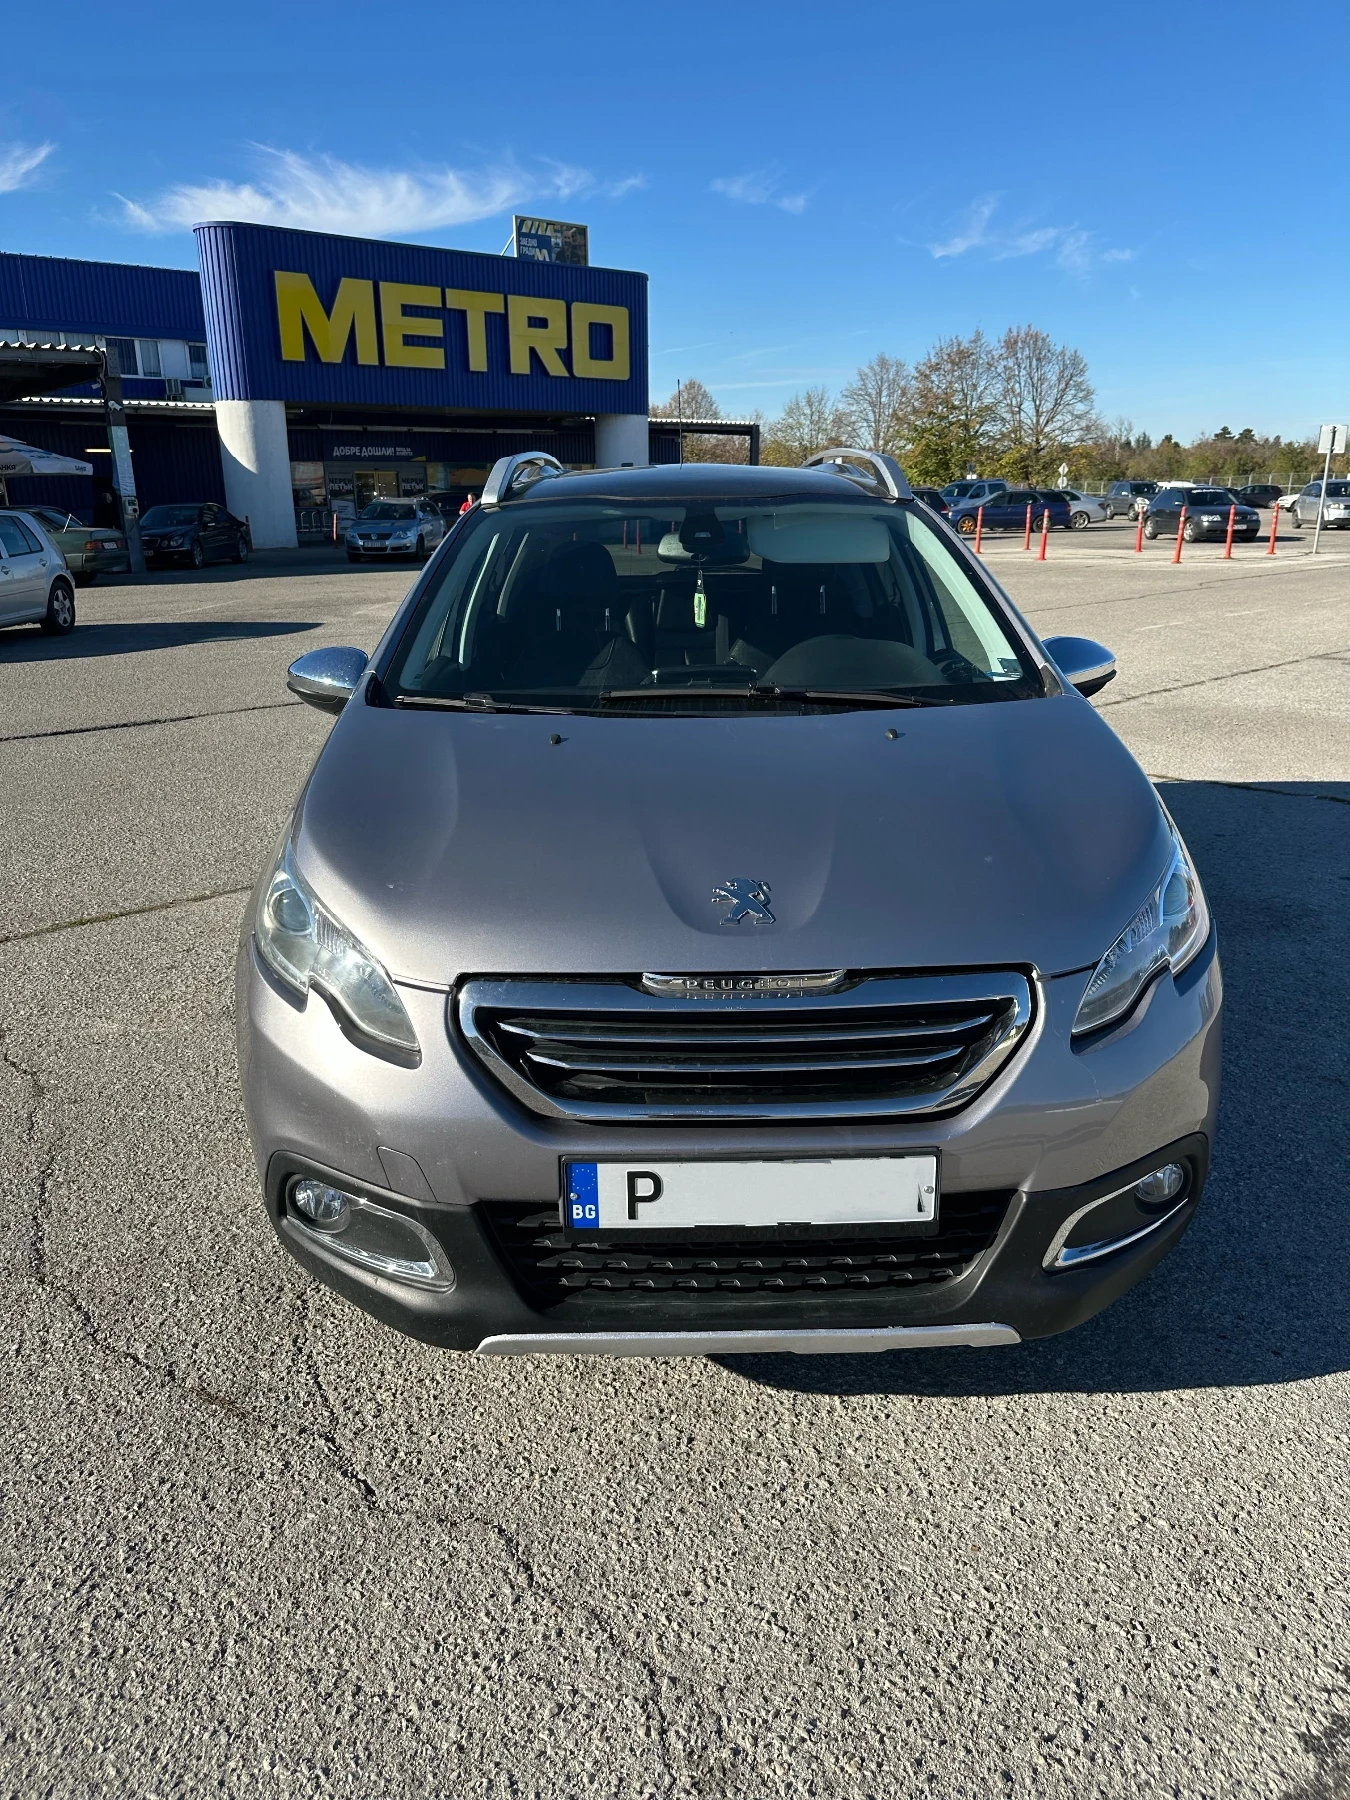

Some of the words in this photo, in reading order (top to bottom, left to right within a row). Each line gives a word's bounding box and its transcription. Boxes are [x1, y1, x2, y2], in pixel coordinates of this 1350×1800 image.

[274, 269, 631, 381] METRO
[333, 446, 361, 457] ДОБРЕ
[361, 446, 395, 457] ДОШЛИ!
[684, 977, 808, 990] PEUGEOT
[626, 1169, 663, 1220] P
[572, 1204, 596, 1219] BG
